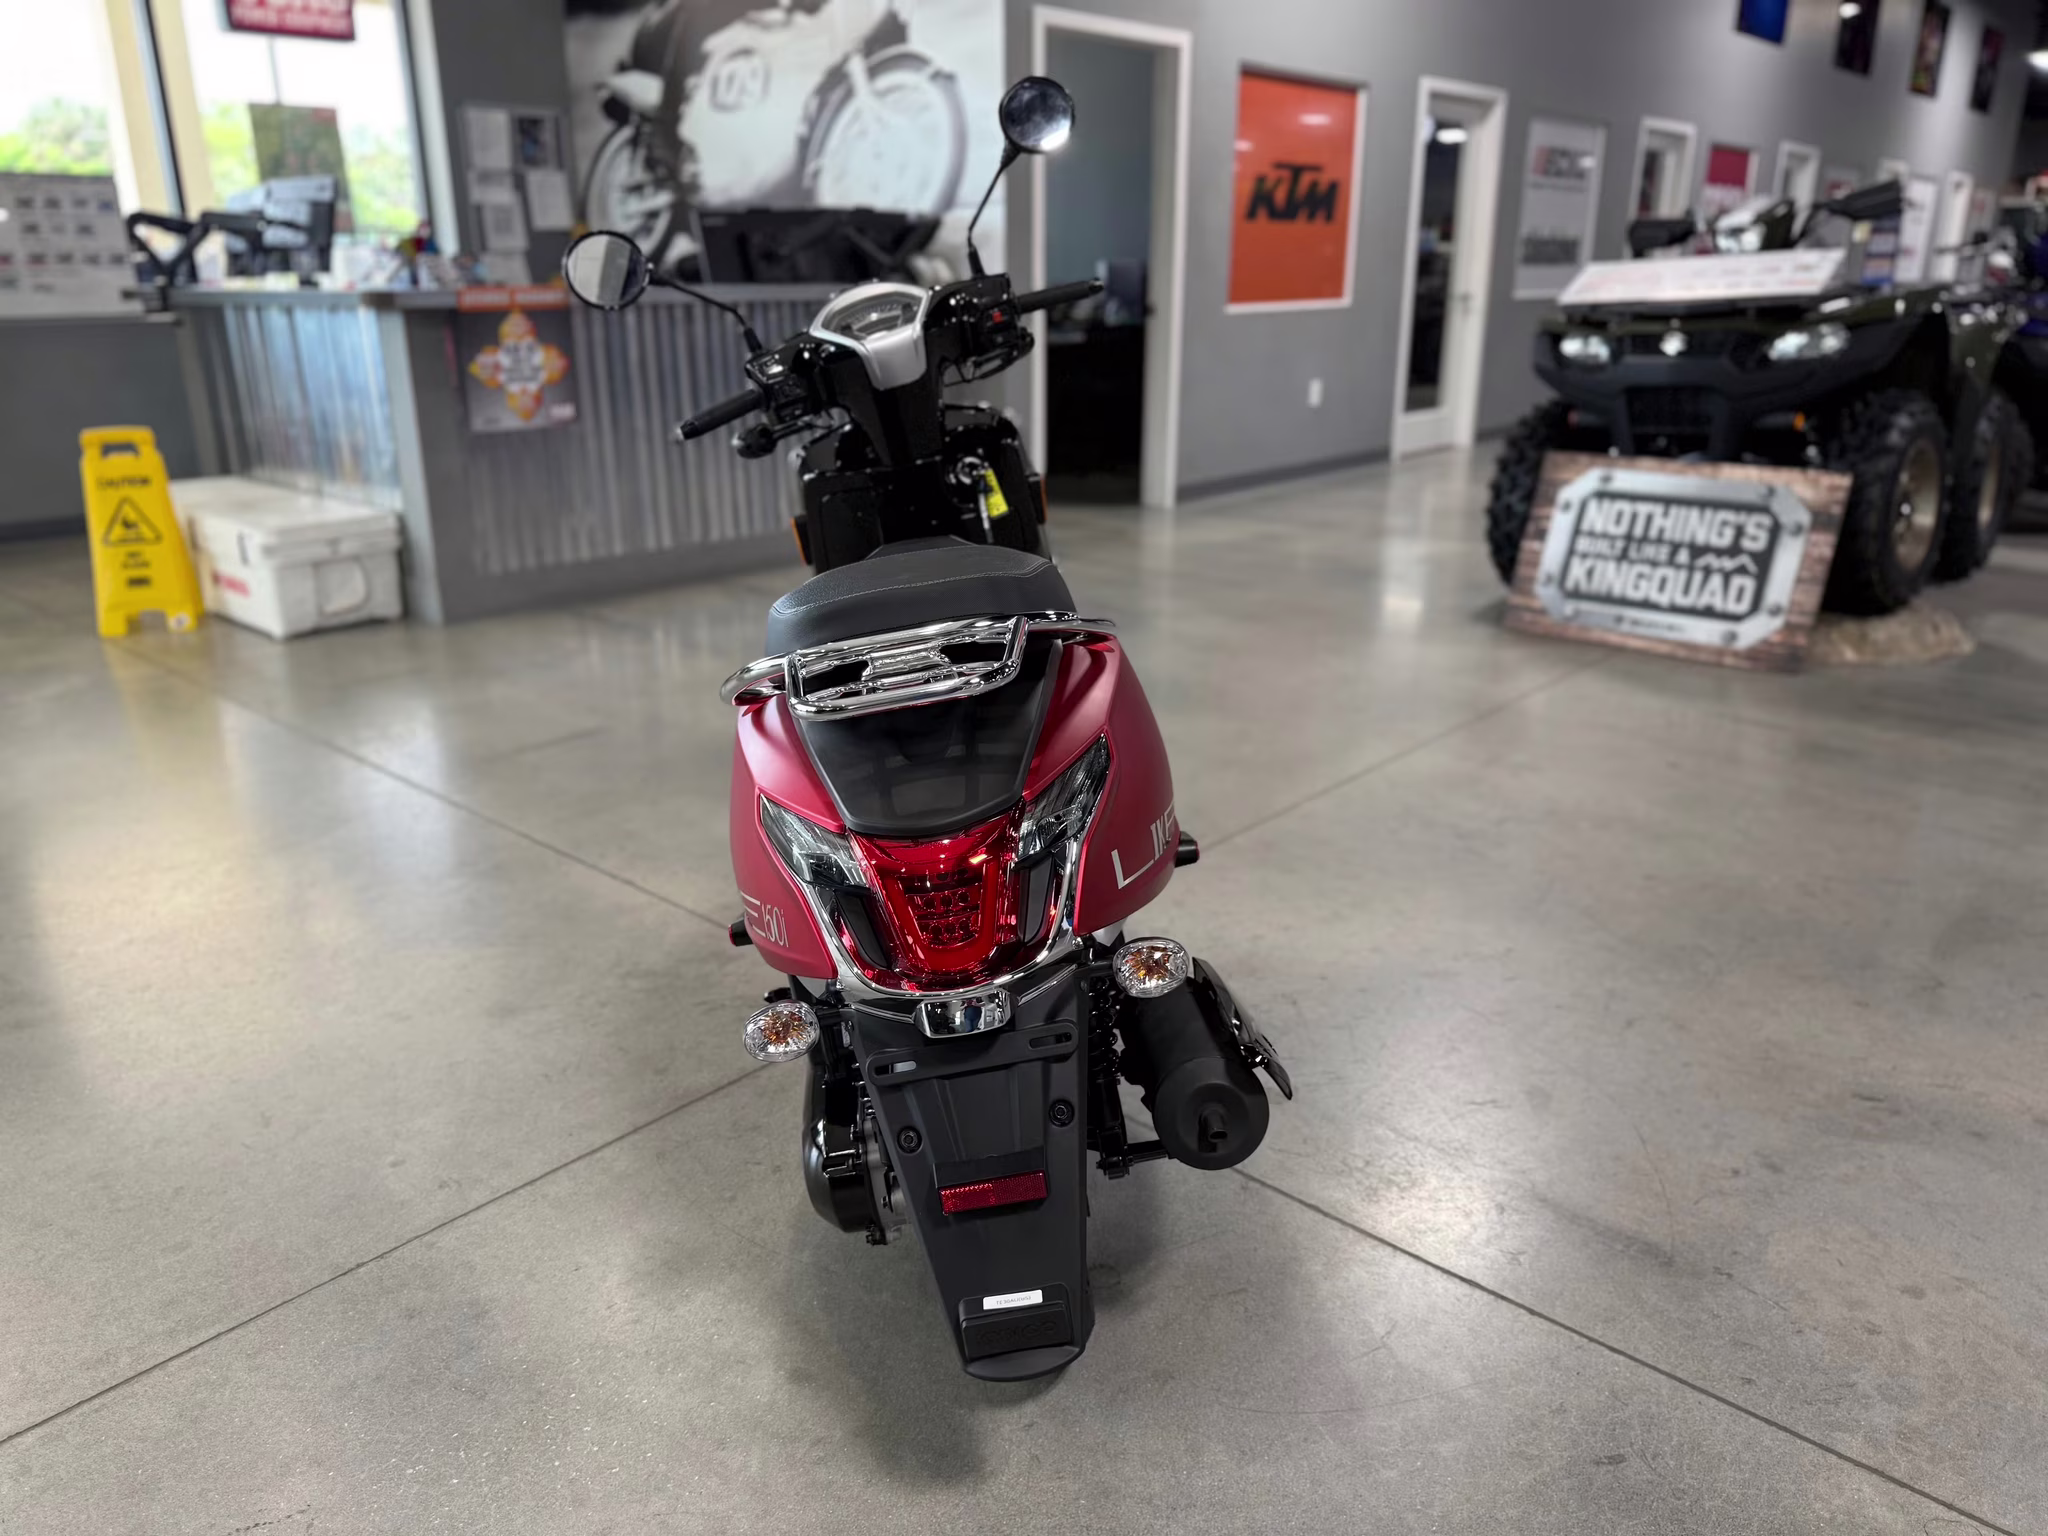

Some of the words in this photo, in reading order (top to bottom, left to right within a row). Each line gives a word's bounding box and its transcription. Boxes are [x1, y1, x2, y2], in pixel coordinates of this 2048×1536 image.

[1246, 161, 1339, 224] KTM
[1580, 498, 1773, 552] NOTHING'S
[1629, 541, 1672, 563] LIKE
[1674, 547, 1691, 566] A
[1564, 555, 1758, 616] KINGQUAD
